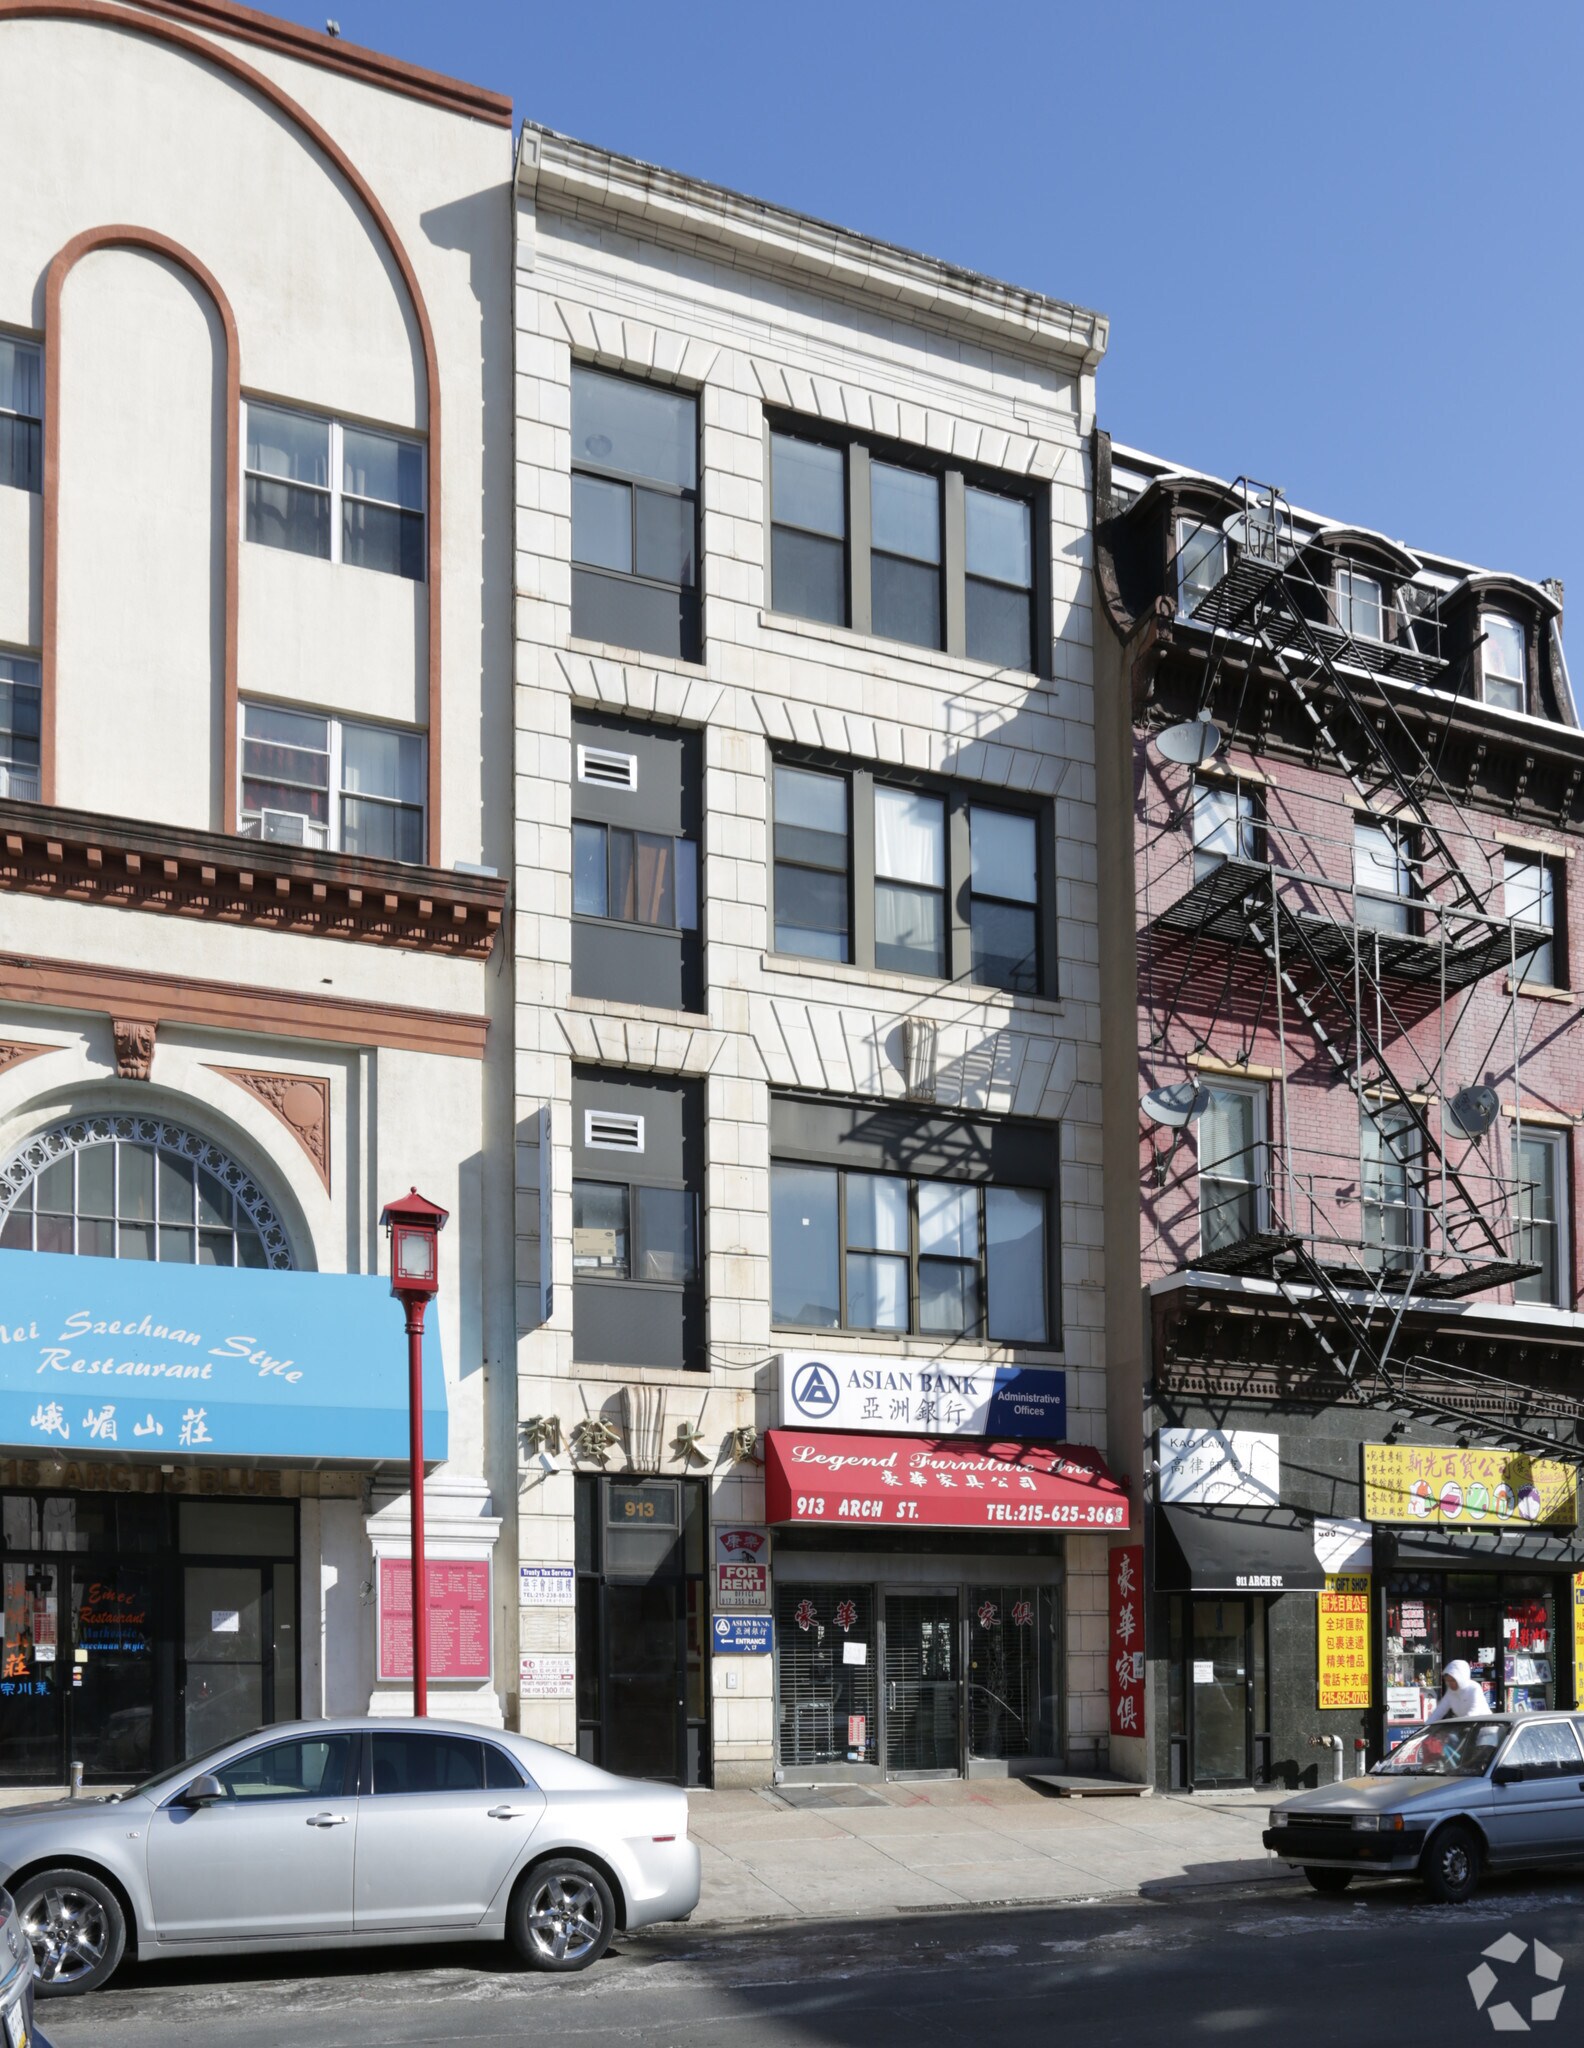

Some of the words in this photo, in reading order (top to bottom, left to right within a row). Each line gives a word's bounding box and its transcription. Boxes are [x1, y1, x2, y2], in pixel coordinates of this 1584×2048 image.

[58, 1311, 201, 1346] Szechuan
[208, 1336, 303, 1384] Style
[36, 1348, 213, 1380] Restaurant
[847, 1369, 913, 1392] ASIAN
[920, 1374, 979, 1396] BANK
[998, 1391, 1061, 1405] Administrative
[860, 1396, 967, 1426] 亞洲銀行
[1014, 1404, 1045, 1416] Offices
[791, 1445, 898, 1471] Legend
[909, 1452, 1036, 1473] Furniture
[1047, 1458, 1101, 1475] Inc.
[1406, 1449, 1511, 1481] 新光百貨公司
[61, 1463, 187, 1492] ARCTIC
[199, 1466, 283, 1497] BLUE
[624, 1501, 656, 1517] 913
[796, 1496, 825, 1515] 913
[838, 1498, 883, 1518] ARCH
[896, 1501, 919, 1519] ST.
[551, 1569, 572, 1577] Service
[726, 1566, 758, 1578] FOR
[721, 1579, 764, 1590] RENT
[1236, 1575, 1248, 1587] 911
[1248, 1575, 1271, 1587] ARCH
[1271, 1575, 1284, 1587] ST.
[1336, 1578, 1350, 1592] GIFT
[1352, 1578, 1368, 1592] SHOP
[80, 1605, 146, 1624] Restaurant
[1326, 1617, 1364, 1631] 全球匯款
[1322, 1691, 1369, 1704] 215-625-0703
